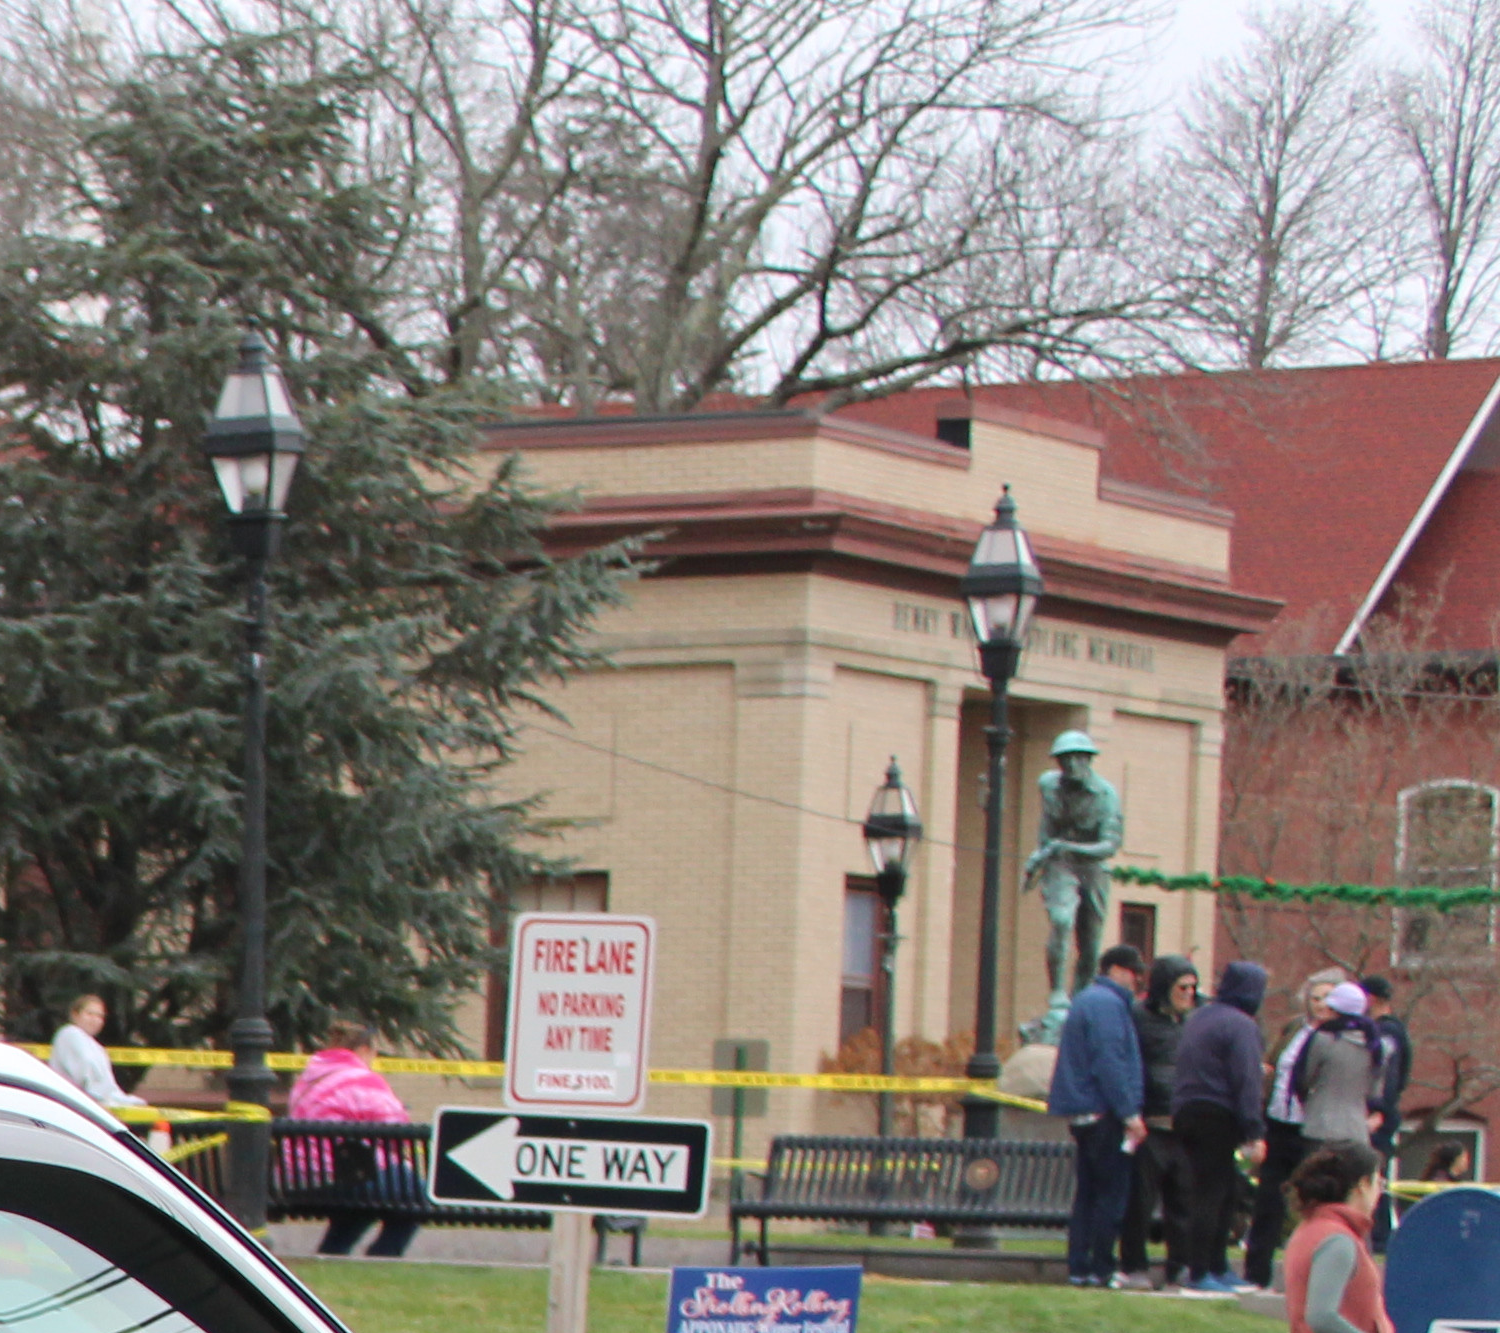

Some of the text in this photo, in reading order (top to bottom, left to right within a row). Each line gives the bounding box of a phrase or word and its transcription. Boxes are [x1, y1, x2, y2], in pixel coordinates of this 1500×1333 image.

[534, 939, 636, 974] FIRE LANE
[538, 992, 625, 1018] NO PARKING
[544, 1026, 613, 1052] ANY TIME
[515, 1141, 676, 1184] ONE WAY
[706, 1272, 744, 1289] The
